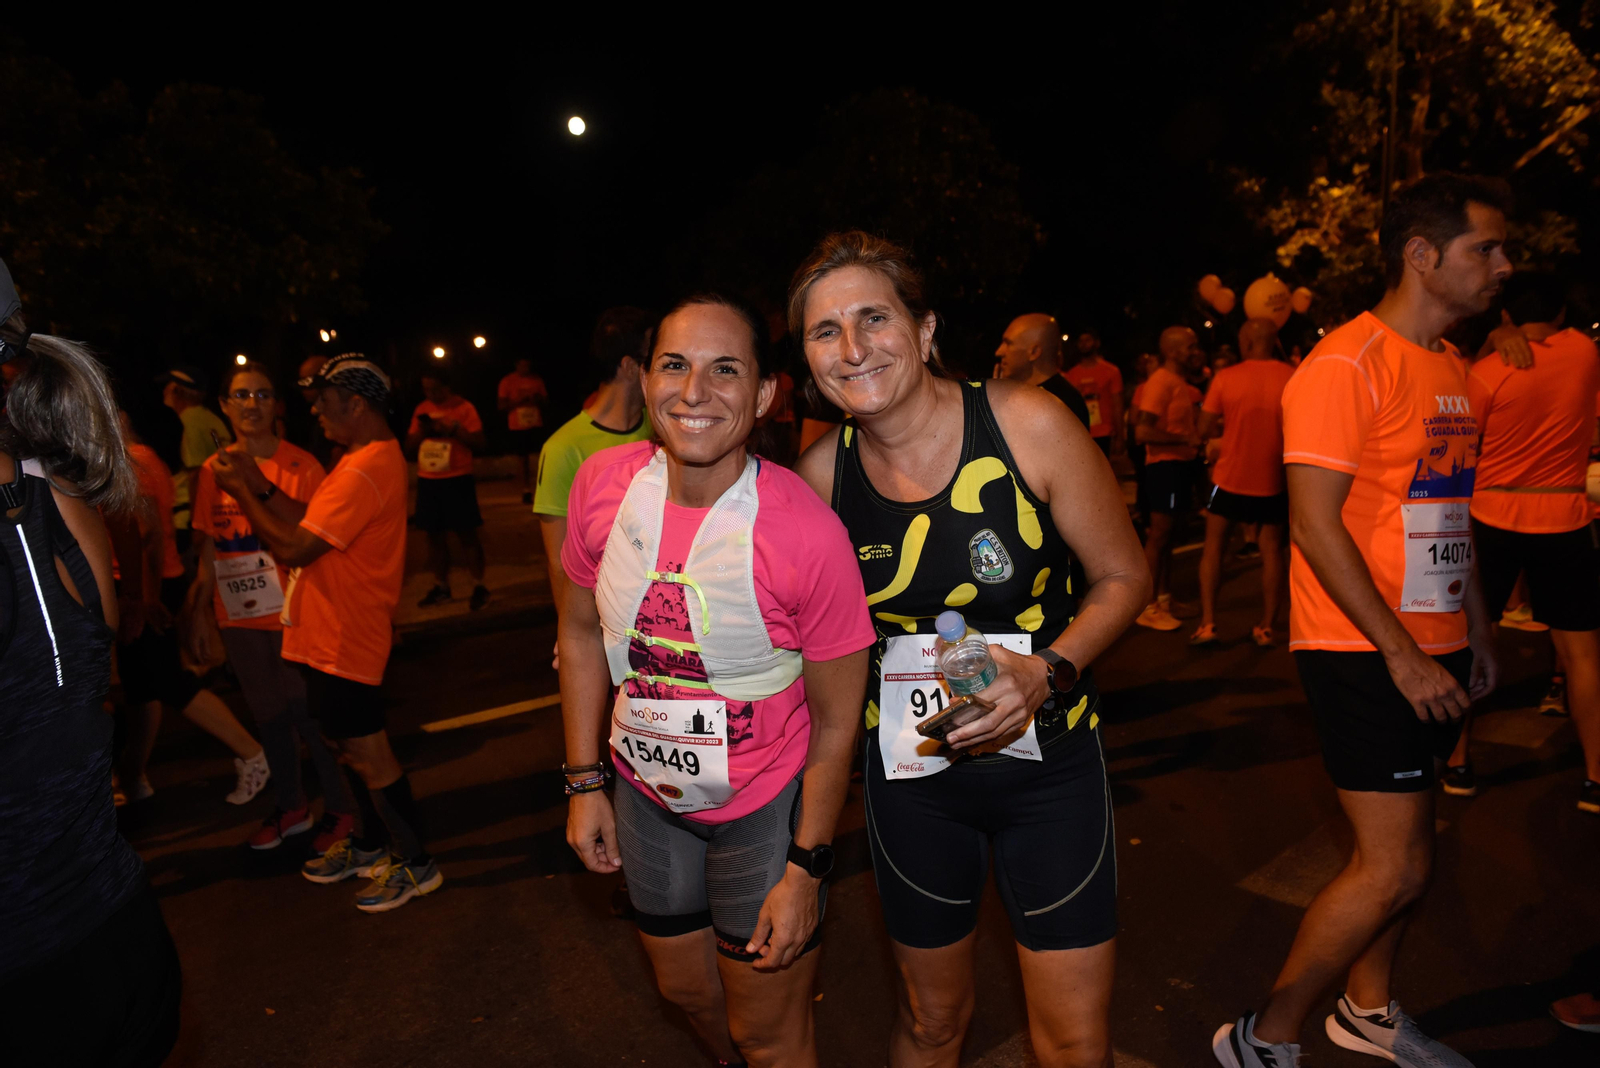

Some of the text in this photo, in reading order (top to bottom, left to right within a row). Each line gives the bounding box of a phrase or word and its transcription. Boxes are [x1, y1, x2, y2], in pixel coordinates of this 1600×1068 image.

[1435, 395, 1470, 414] XXXV
[1423, 416, 1452, 426] CARRERA
[1428, 542, 1471, 565] 14074
[226, 576, 267, 594] 19525
[54, 657, 63, 687] KIPRUN
[621, 736, 700, 776] 15449
